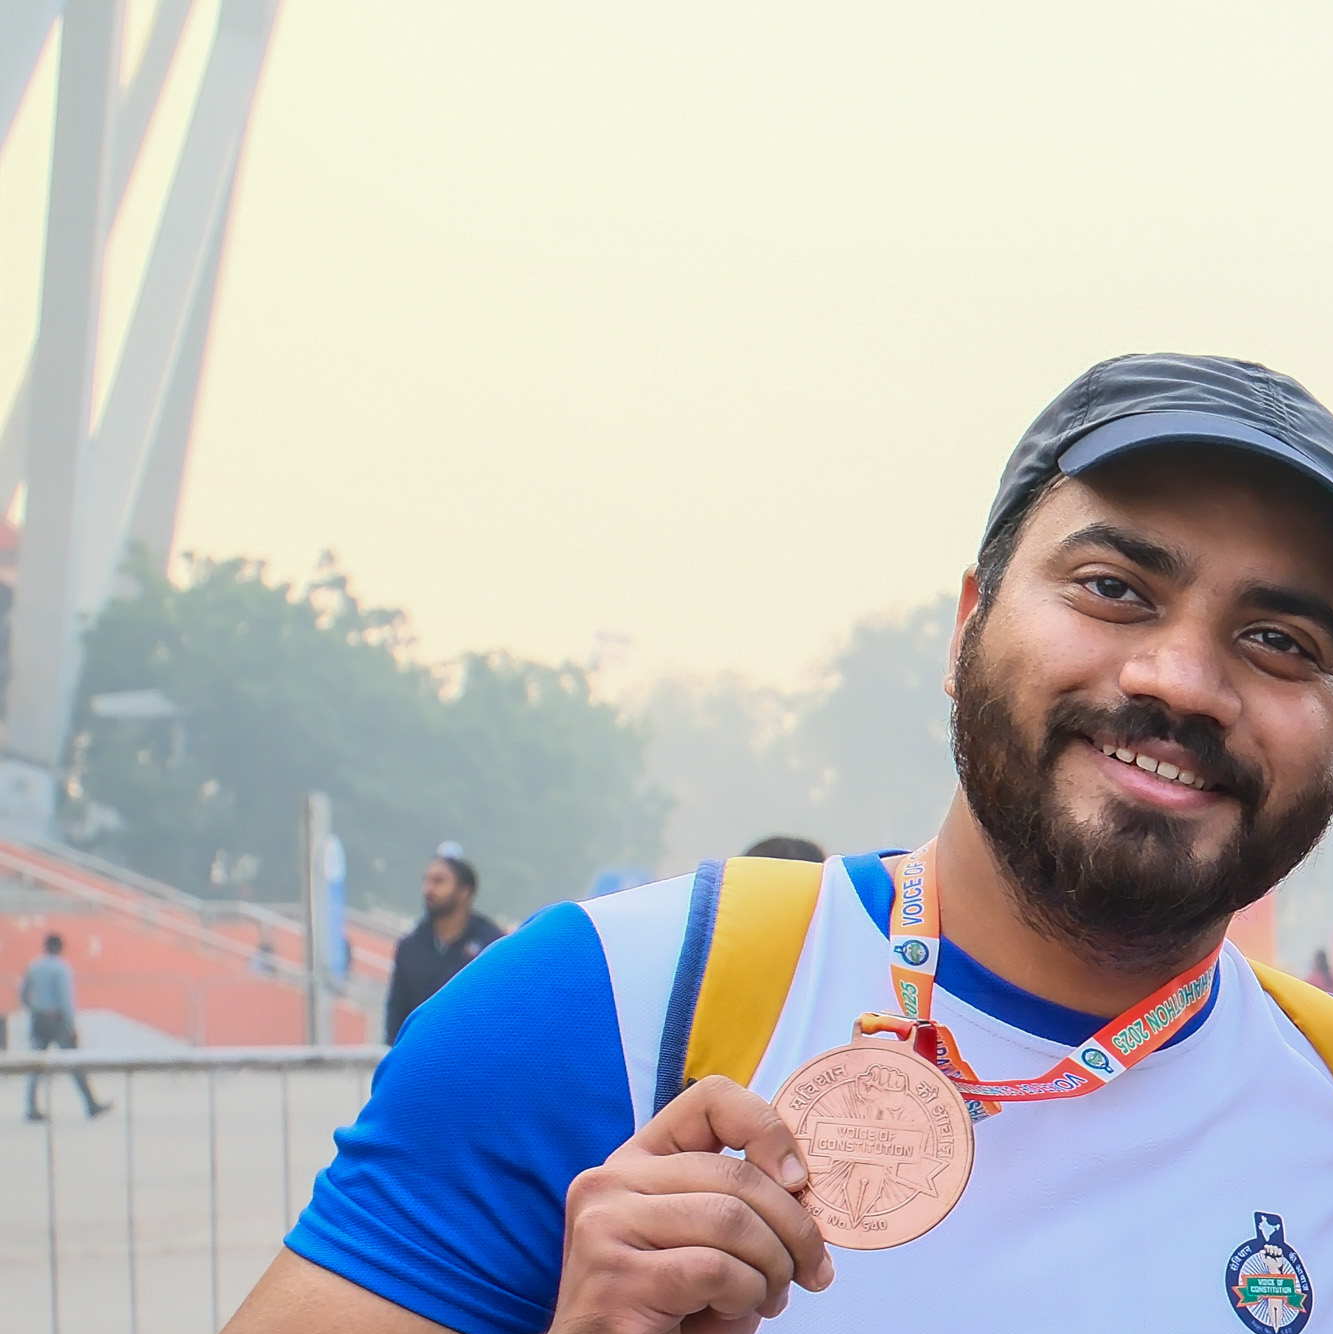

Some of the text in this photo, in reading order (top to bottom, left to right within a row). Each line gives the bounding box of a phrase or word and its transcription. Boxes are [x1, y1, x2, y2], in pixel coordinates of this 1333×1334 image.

[903, 875, 924, 927] VOICE
[1112, 1020, 1149, 1055] 2025
[838, 1127, 897, 1142] VOICE OF
[818, 1138, 914, 1157] CONSTITUTION
[863, 1219, 888, 1233] 540
